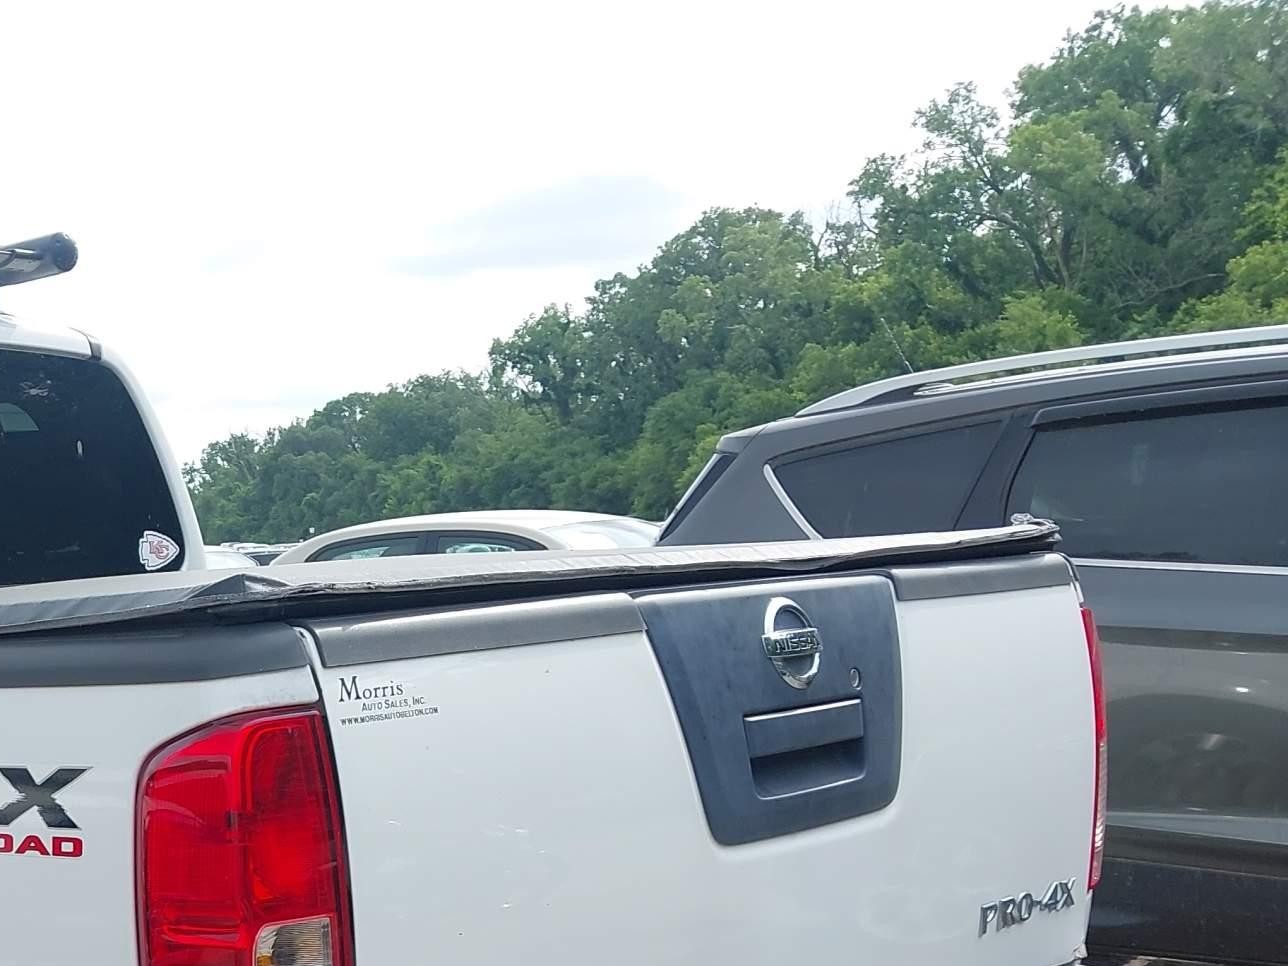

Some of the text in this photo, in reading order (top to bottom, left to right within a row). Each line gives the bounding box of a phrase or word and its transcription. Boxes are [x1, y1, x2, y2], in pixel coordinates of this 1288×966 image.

[149, 540, 170, 560] KC
[339, 676, 404, 702] Morris
[361, 702, 383, 712] AUTO
[978, 877, 1076, 938] PRO-4X
